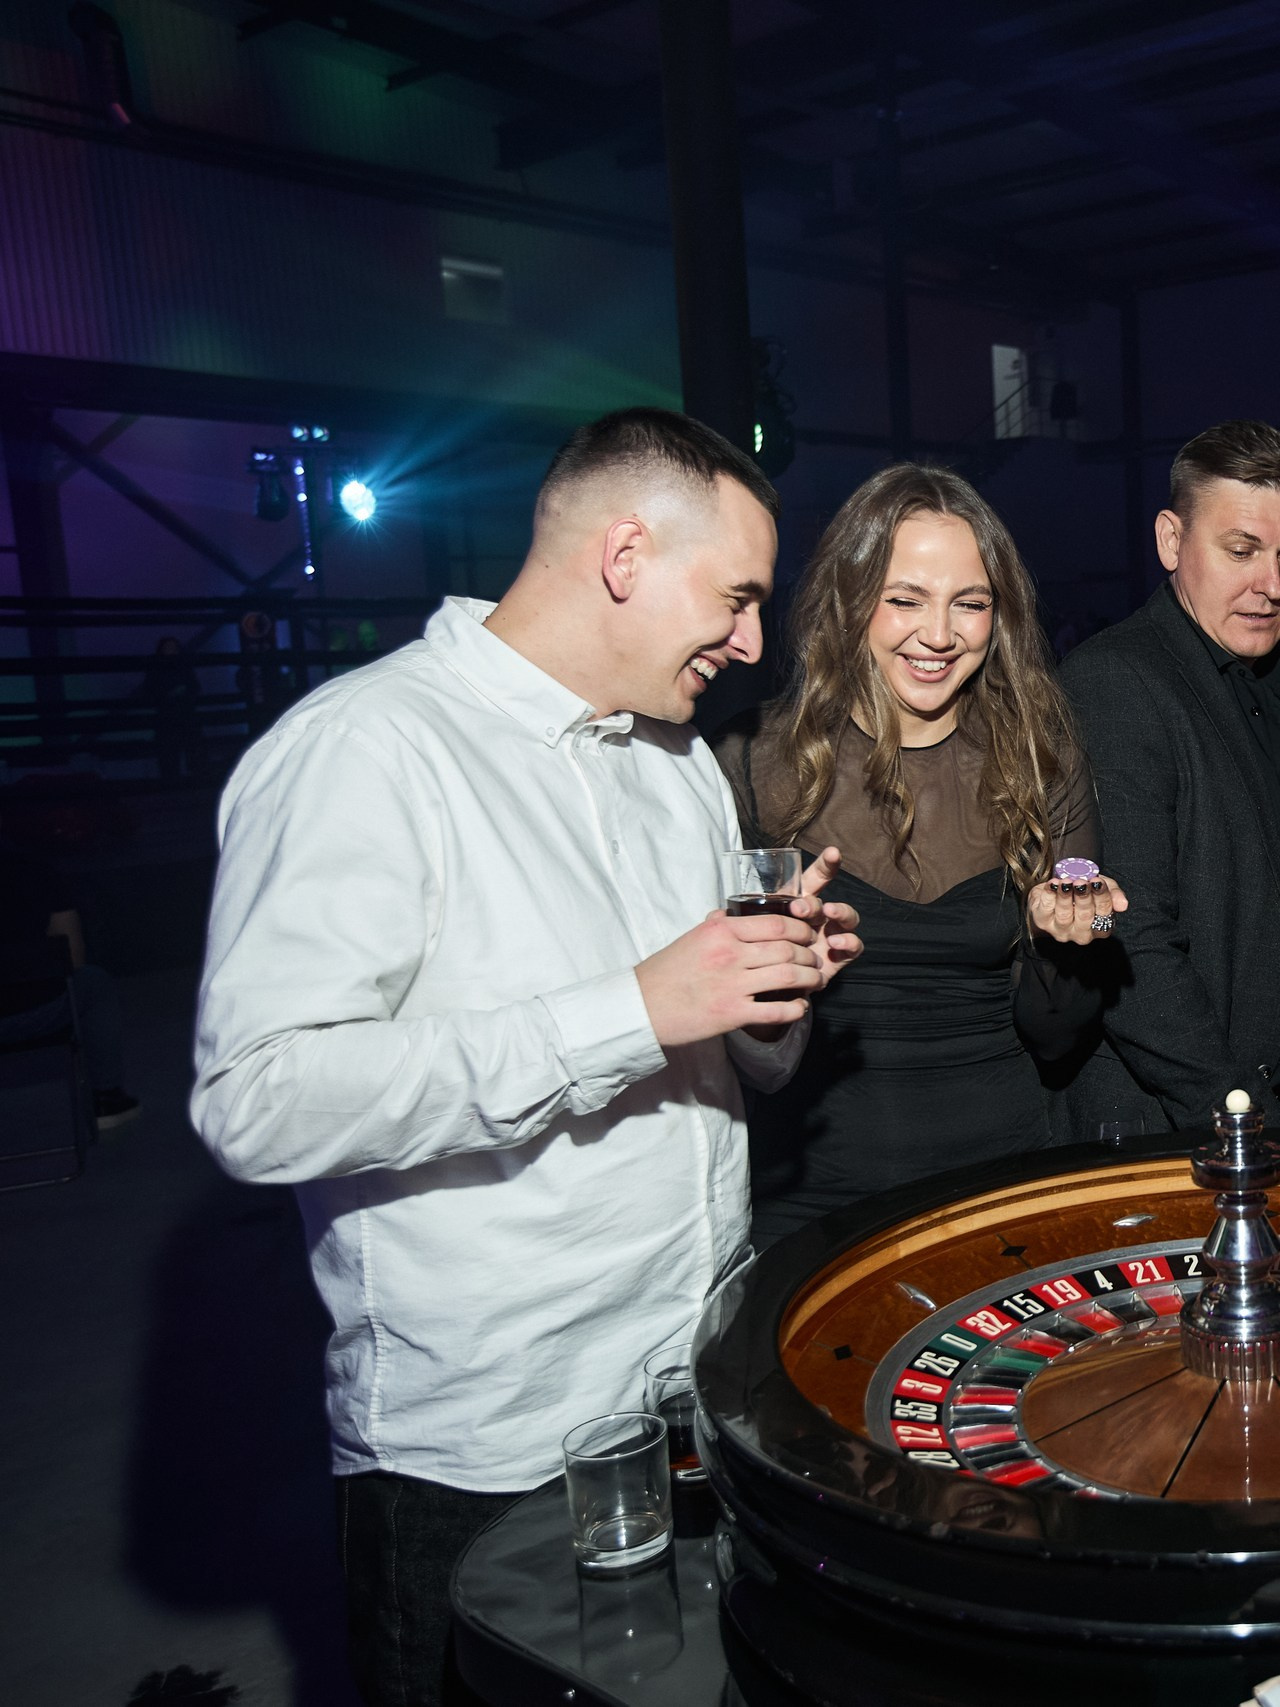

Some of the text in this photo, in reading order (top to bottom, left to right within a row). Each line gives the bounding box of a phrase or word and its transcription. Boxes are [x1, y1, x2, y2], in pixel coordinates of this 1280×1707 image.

[1129, 1260, 1166, 1284] 21
[1183, 1254, 1203, 1277] 2
[1041, 1279, 1083, 1305] 19
[1094, 1270, 1114, 1291] 4
[1002, 1292, 1045, 1320] 15
[965, 1309, 1013, 1336] 32
[940, 1333, 978, 1352] 0
[914, 1350, 960, 1377] 26
[901, 1378, 944, 1395] 3
[894, 1399, 939, 1422] 35
[898, 1424, 945, 1447] 12
